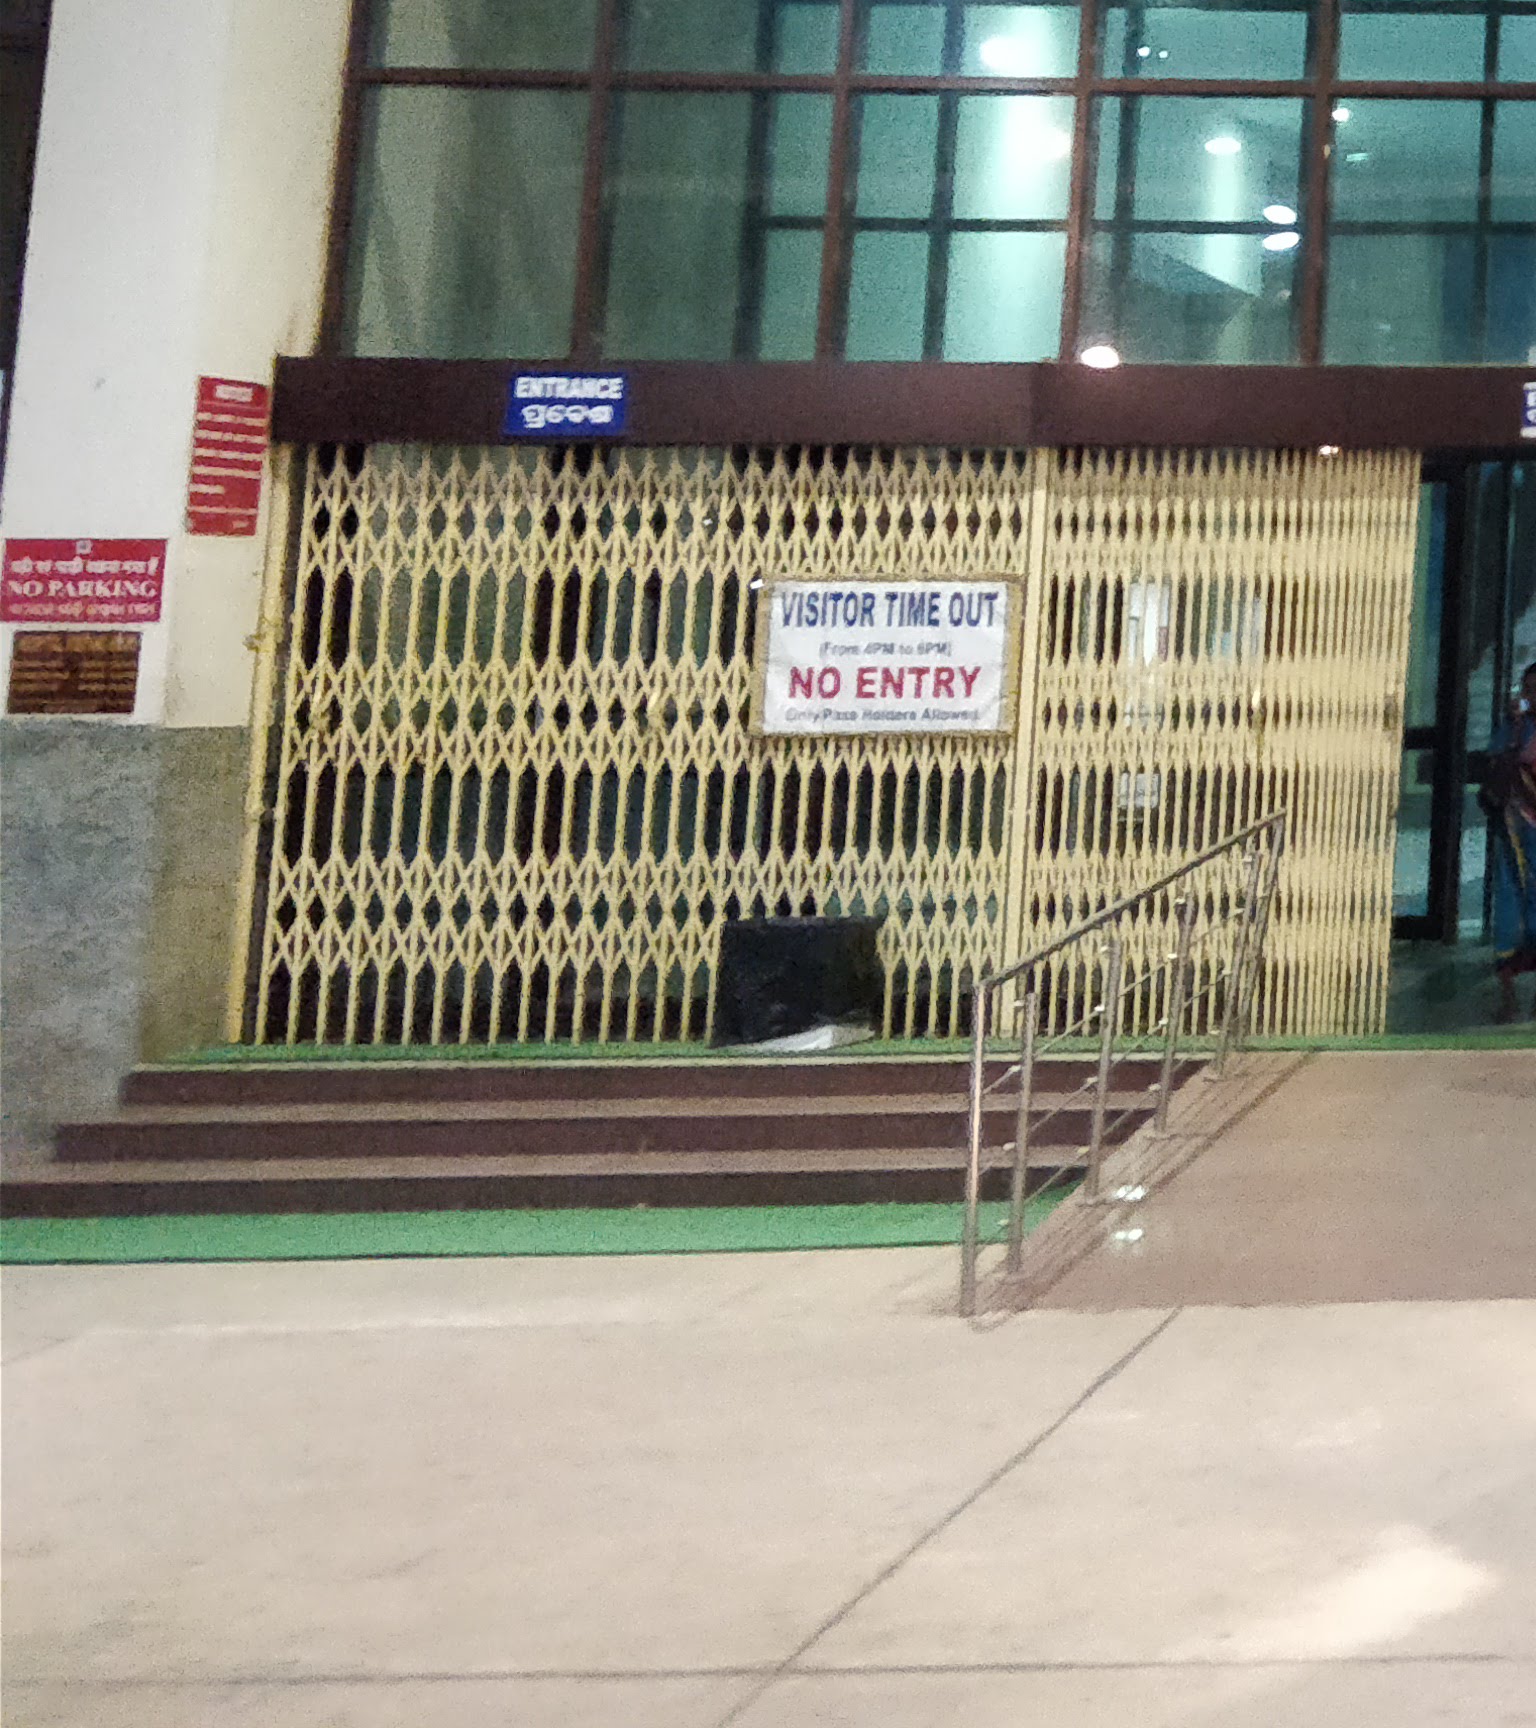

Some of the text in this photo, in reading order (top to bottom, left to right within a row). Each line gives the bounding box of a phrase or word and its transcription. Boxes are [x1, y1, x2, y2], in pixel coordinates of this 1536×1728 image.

[514, 376, 624, 399] ENTRANCE
[8, 579, 157, 597] NO PARKING
[781, 591, 998, 628] VISITOR TIME OUT
[788, 665, 982, 699] NO ENTRY
